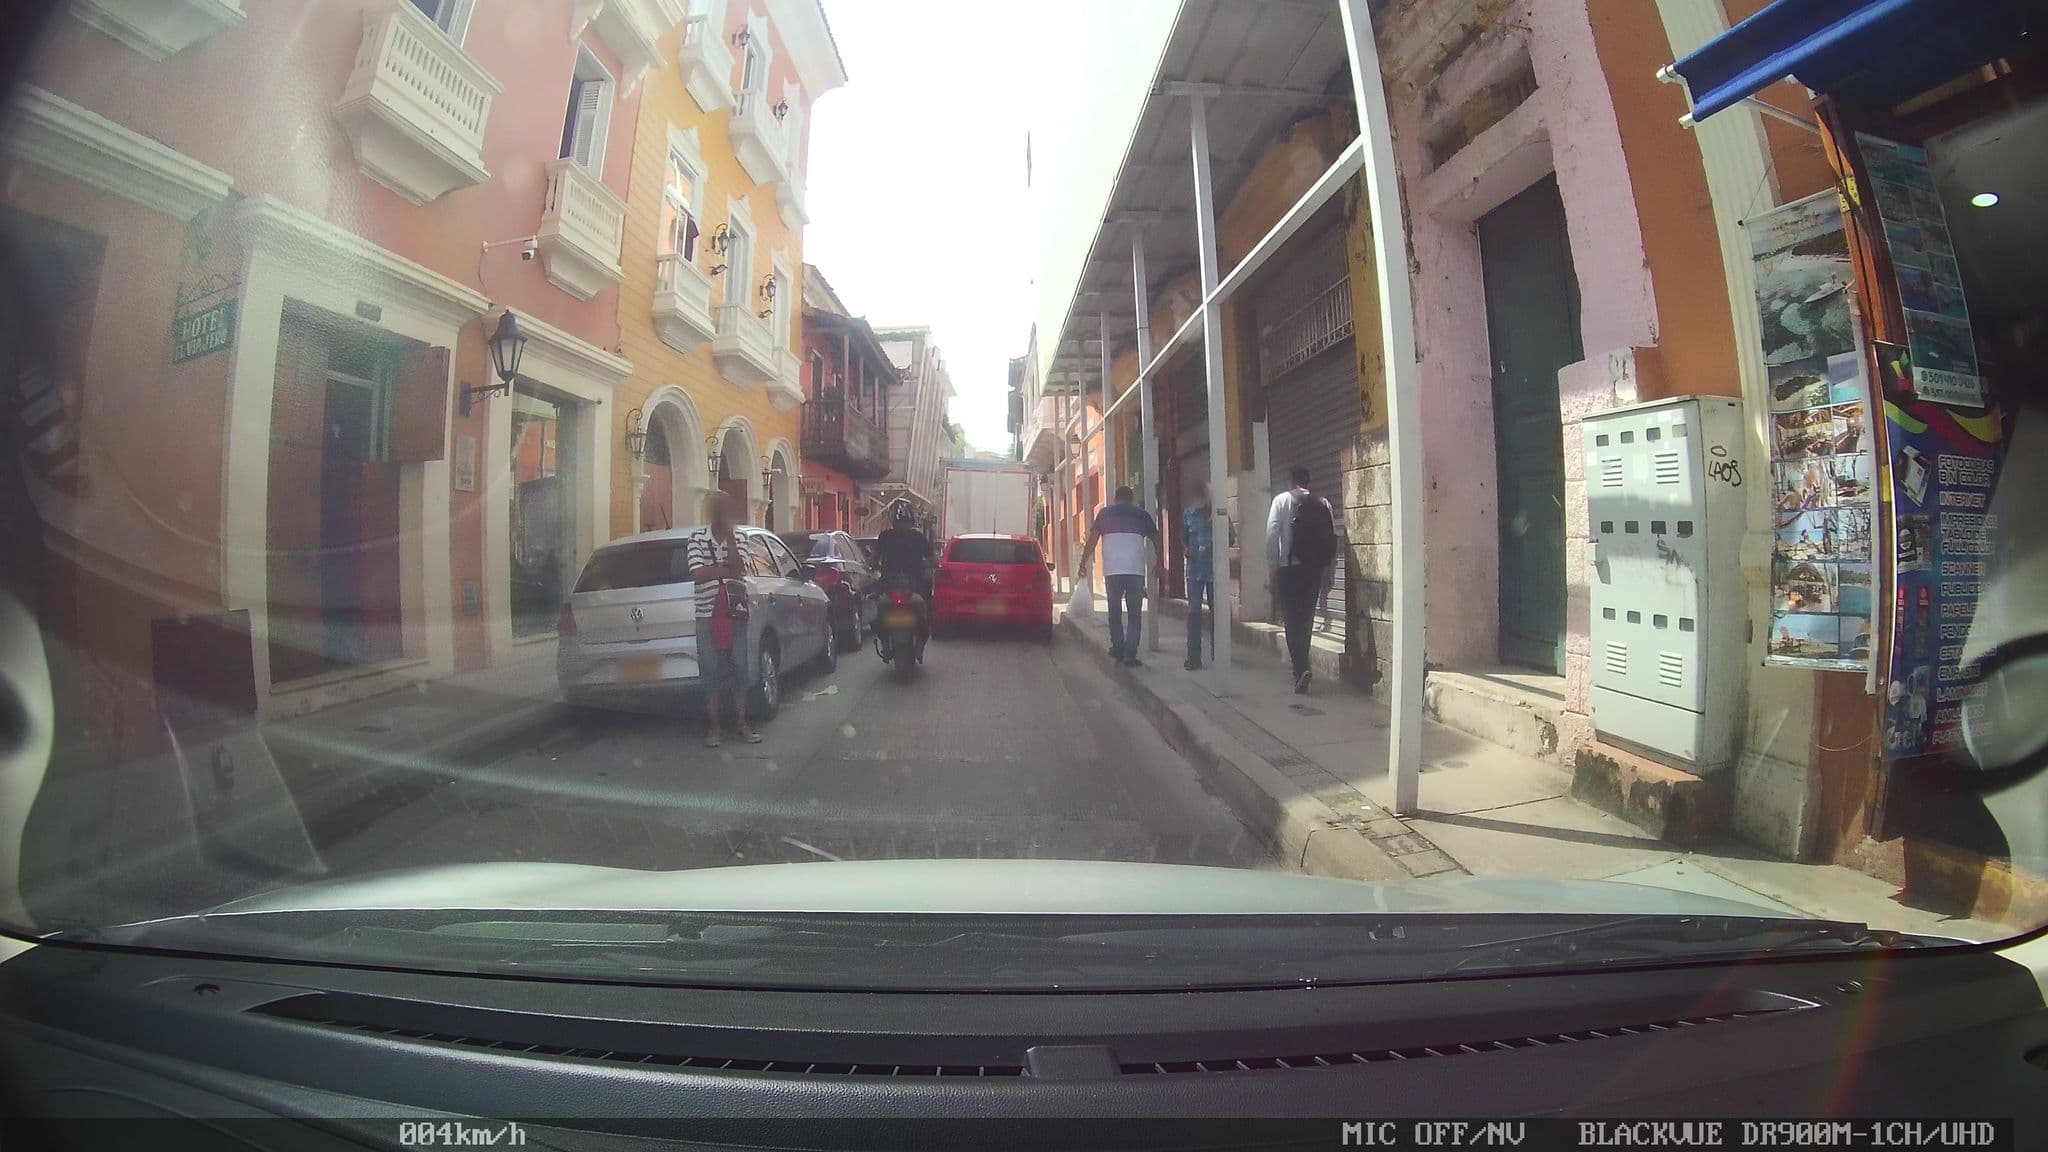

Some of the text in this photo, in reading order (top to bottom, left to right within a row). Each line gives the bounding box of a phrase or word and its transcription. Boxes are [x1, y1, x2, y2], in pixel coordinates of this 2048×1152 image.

[1959, 472, 1990, 488] COLOR
[1939, 491, 1986, 508] INTERNET
[1941, 561, 1986, 576] SCANNER
